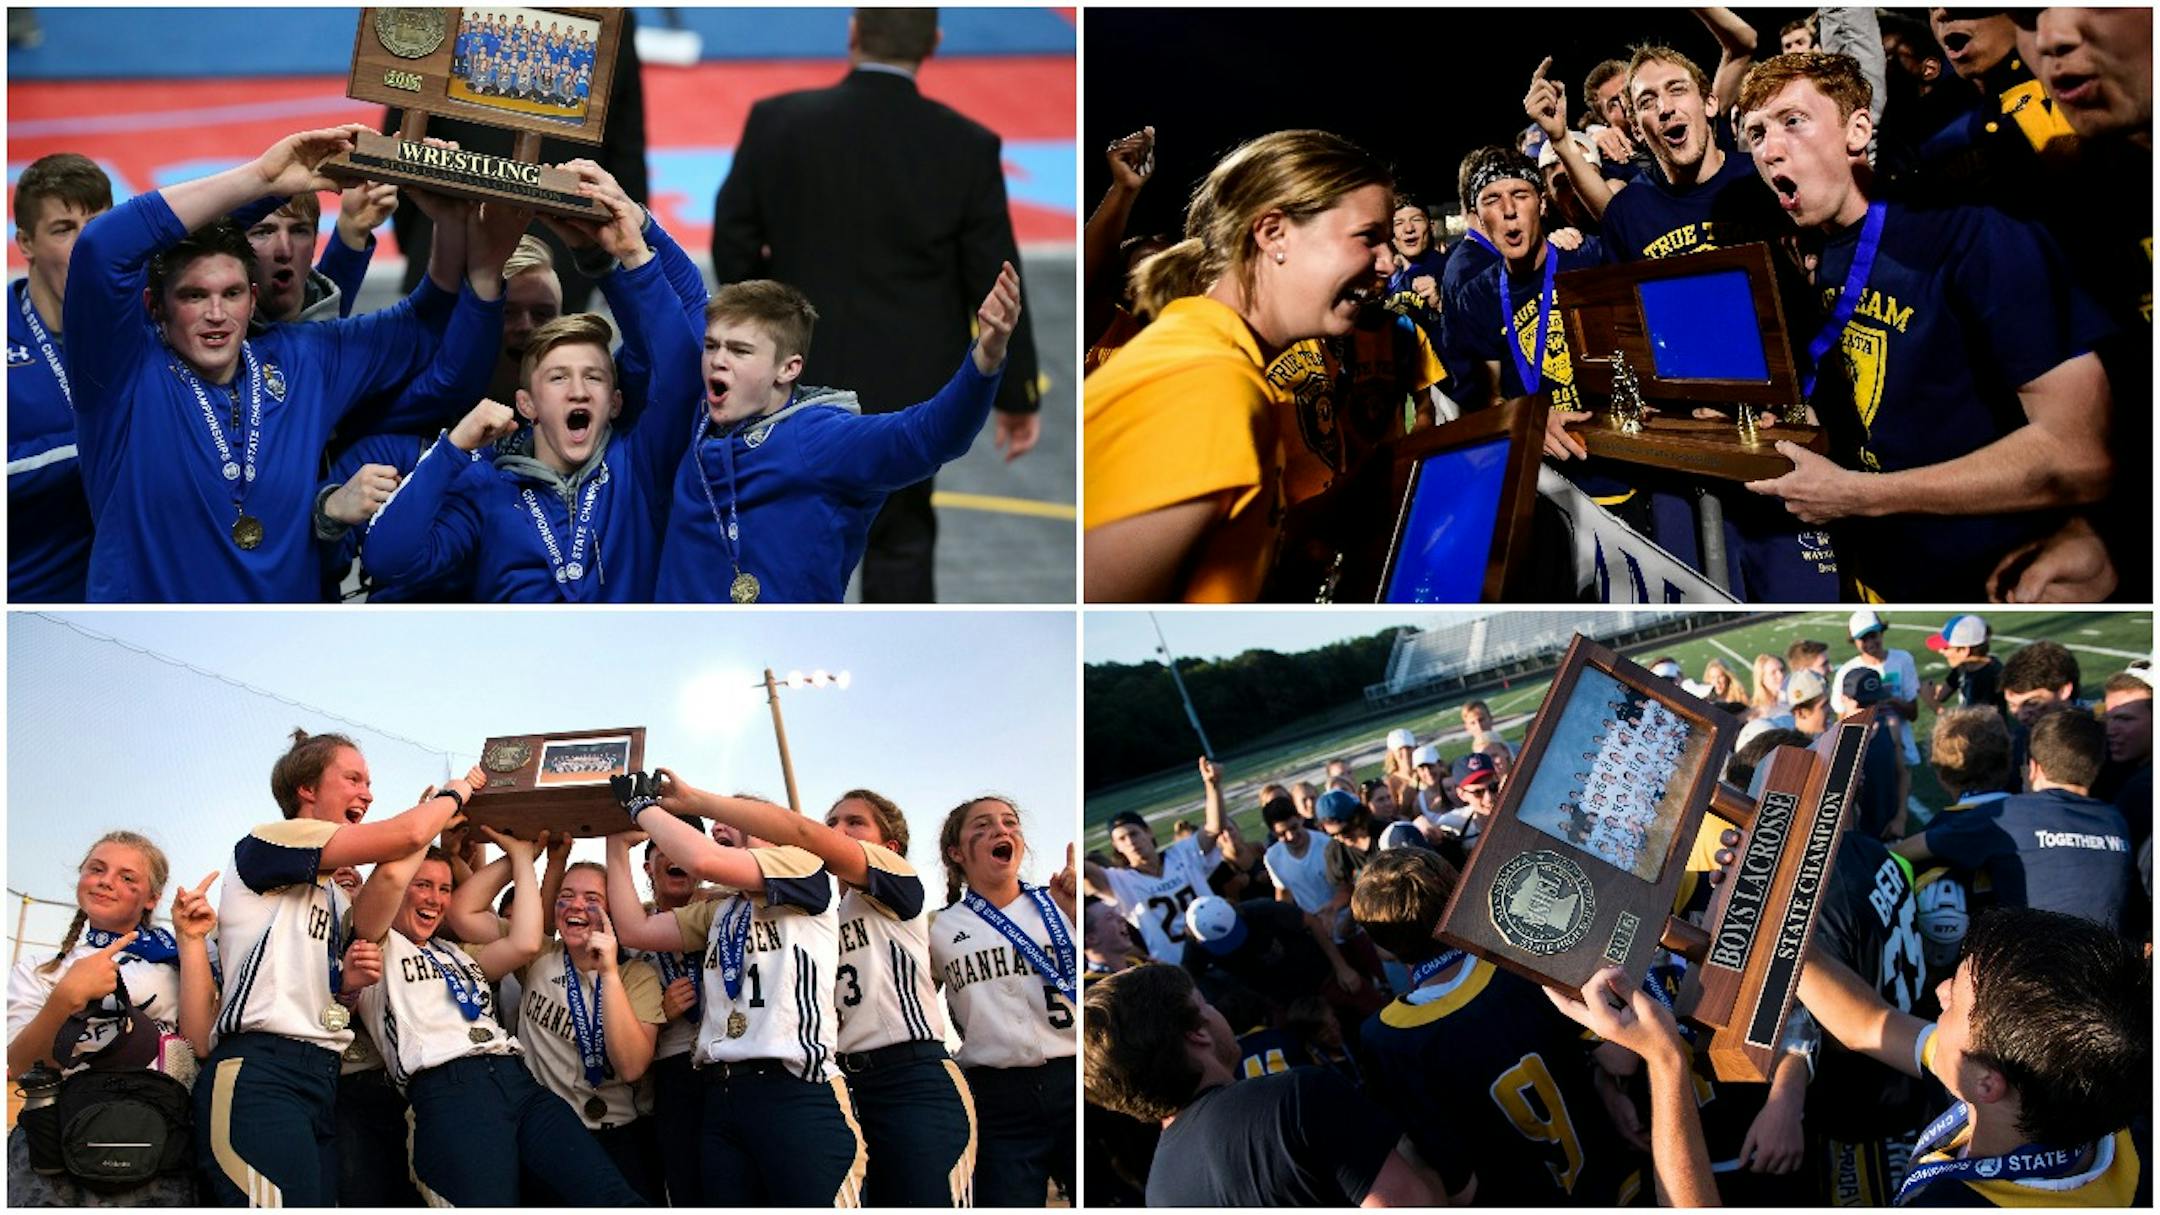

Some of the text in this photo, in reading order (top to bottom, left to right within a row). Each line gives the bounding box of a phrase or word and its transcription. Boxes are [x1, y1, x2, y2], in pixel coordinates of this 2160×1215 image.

[402, 143, 539, 184] WRESTLING
[1642, 224, 1698, 259] TRUE
[571, 526, 587, 560] STATE
[1714, 793, 1794, 968] BOYS LACROSSE
[1777, 791, 1843, 960] STATE CHAMPION
[1608, 916, 1635, 962] 2016
[747, 963, 765, 1008] 1
[1043, 985, 1075, 1029] 5
[1490, 1052, 1586, 1195] 9
[2008, 1149, 2069, 1172] STATE
